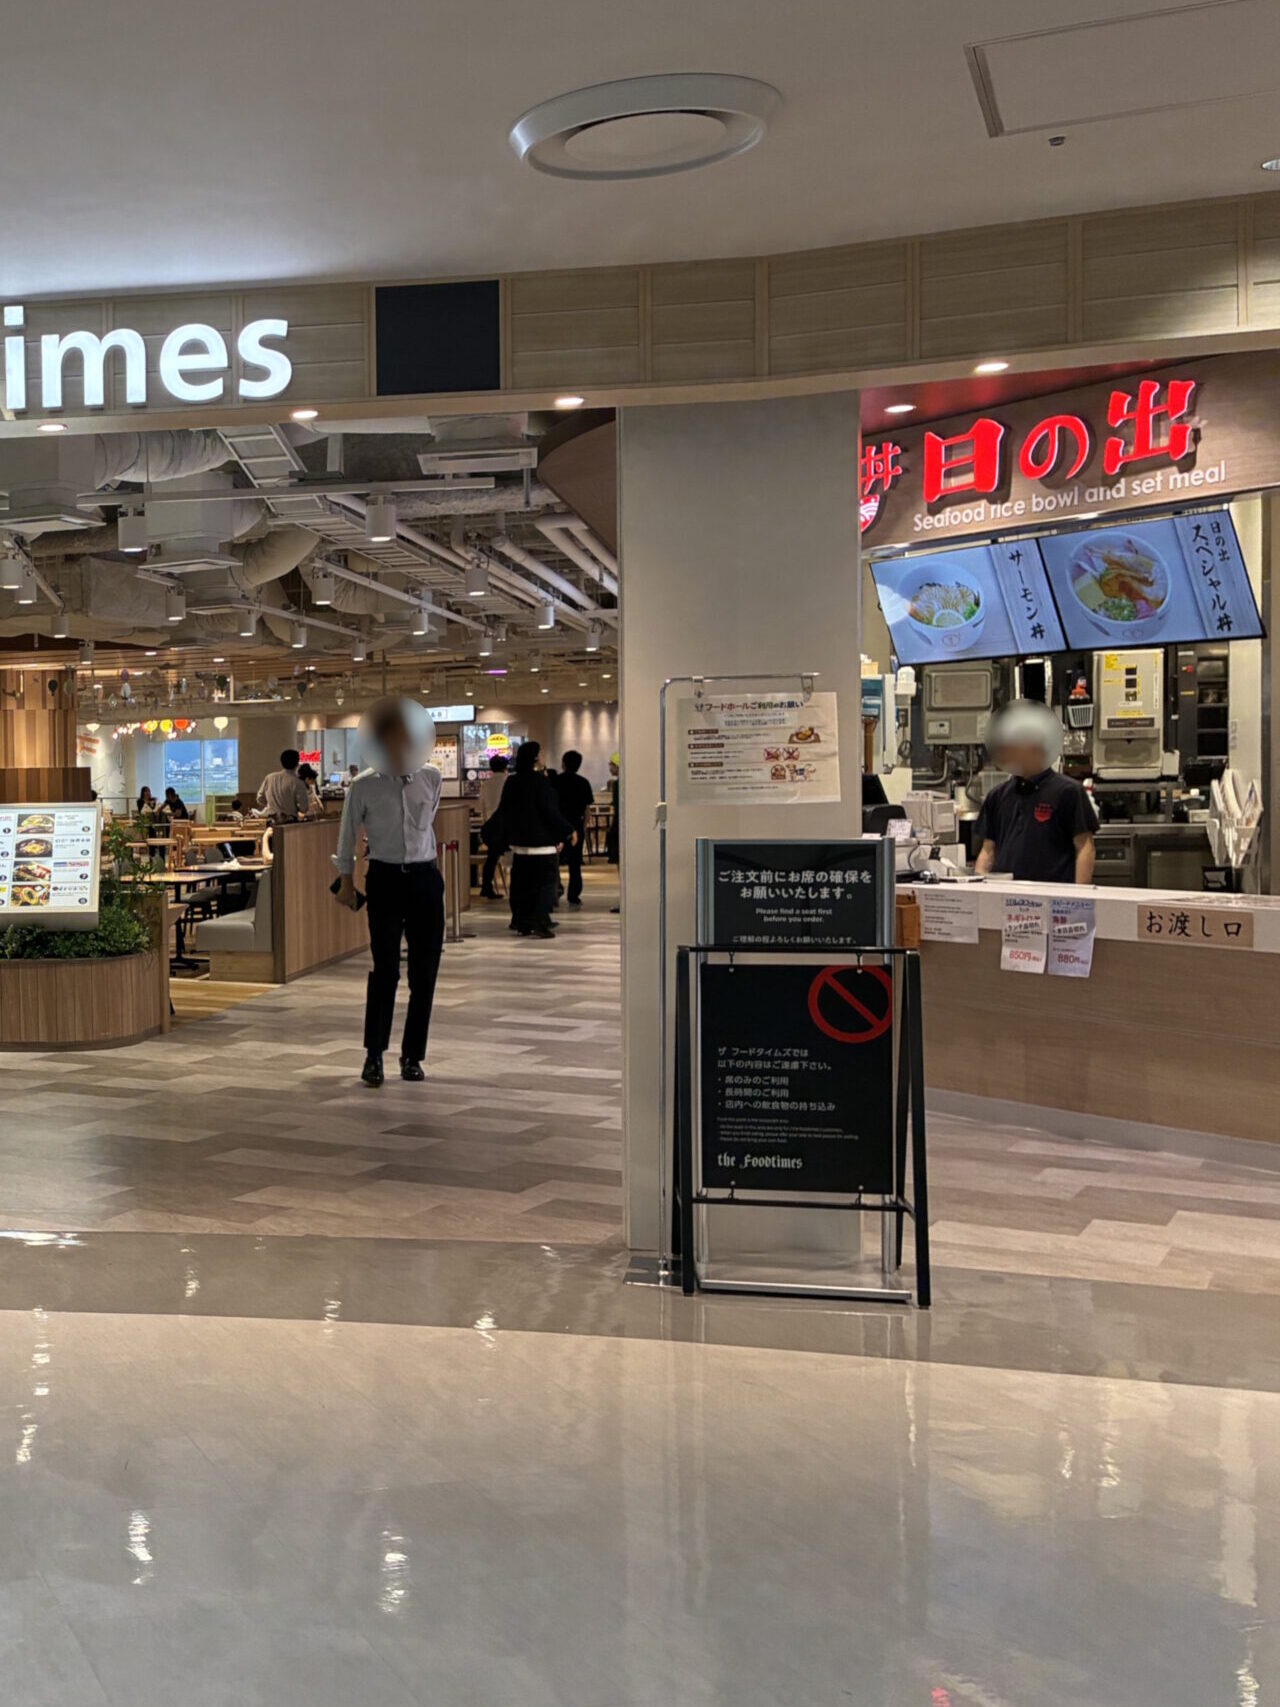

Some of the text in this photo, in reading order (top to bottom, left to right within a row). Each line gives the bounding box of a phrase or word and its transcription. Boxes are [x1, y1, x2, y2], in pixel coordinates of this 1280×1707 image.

[923, 380, 1196, 503] 日の出
[913, 460, 1226, 532] Seafood rice bowl and set meal
[1210, 521, 1230, 562] 日の出
[1008, 549, 1045, 640] サーモン丼
[1192, 524, 1233, 632] スペシャル丼
[718, 869, 872, 884] ご注文前にお席の確保を
[740, 885, 853, 900] お願いいたします。
[1146, 911, 1242, 937] お渡し口
[732, 1047, 809, 1058] フードタイムズでは
[717, 1152, 736, 1167] the
